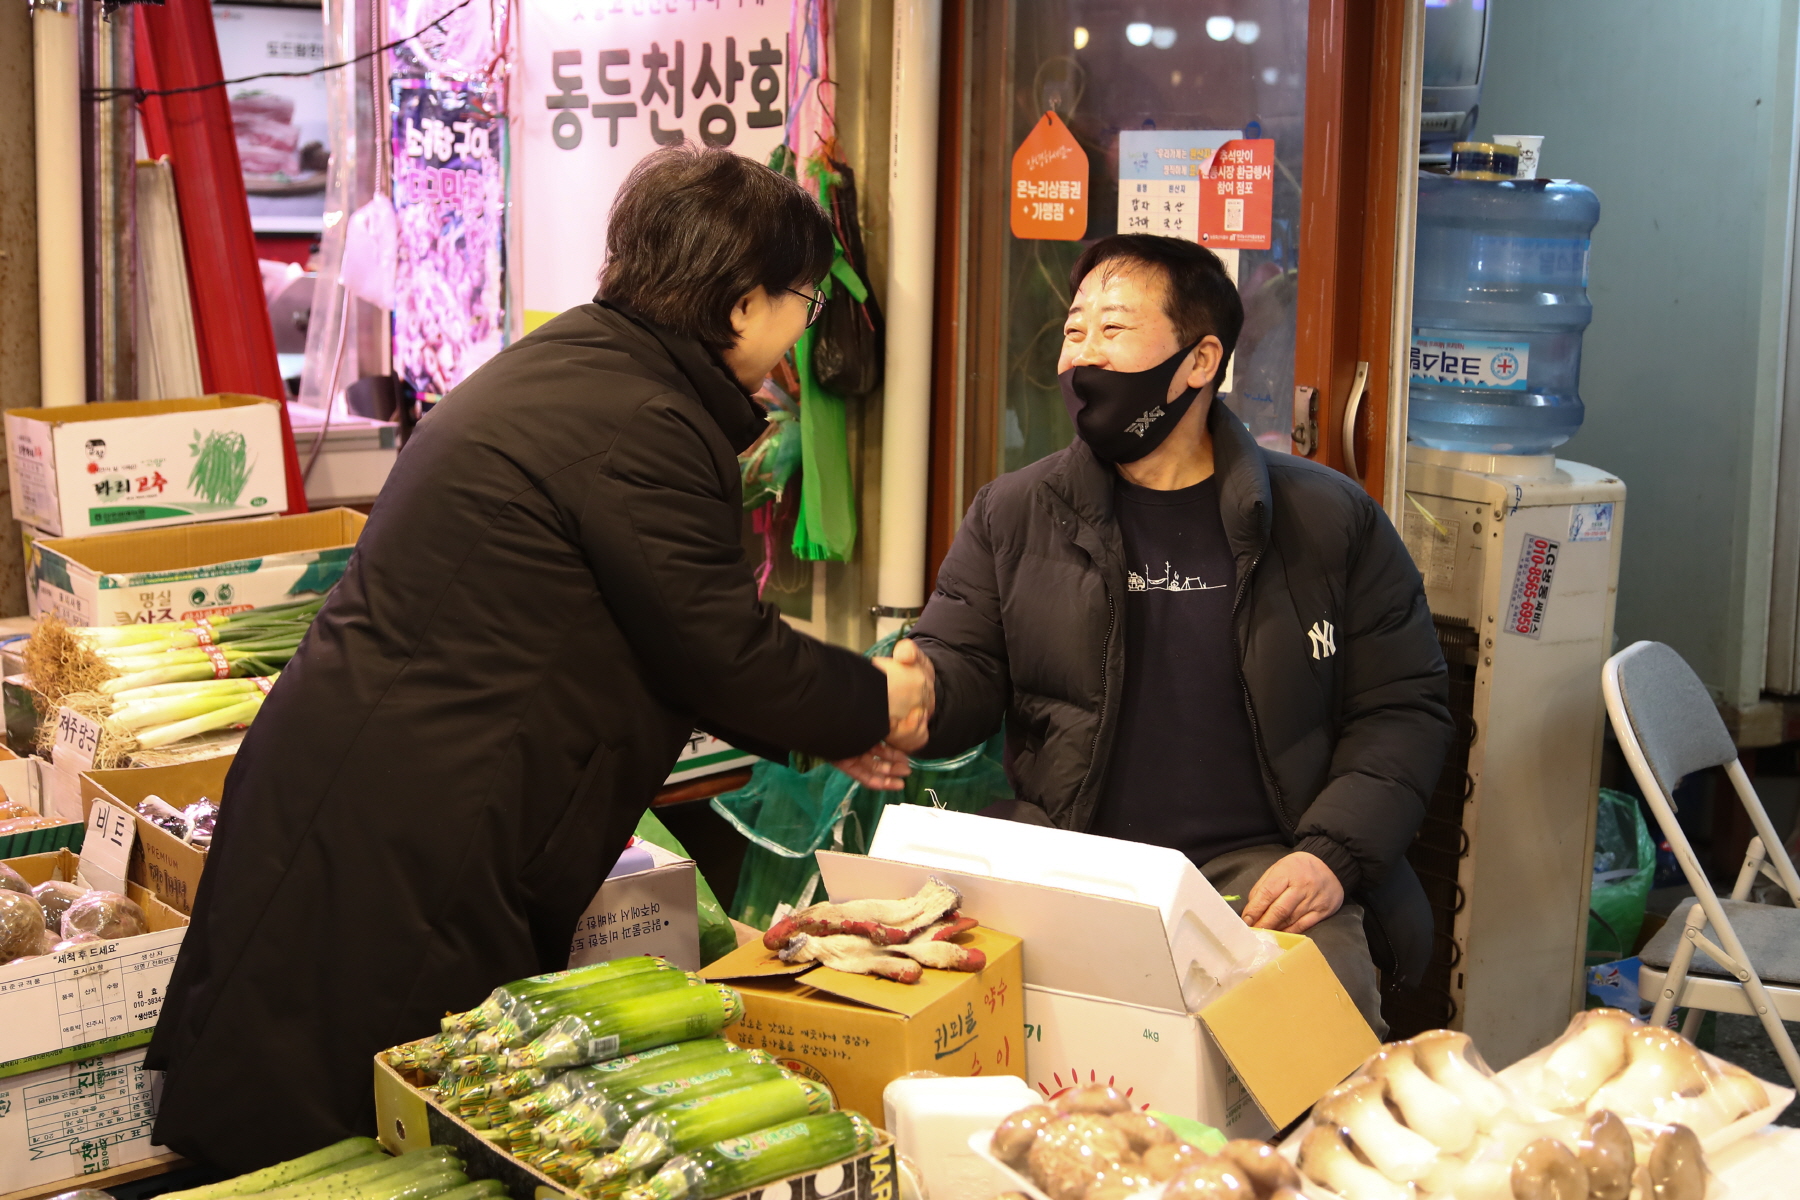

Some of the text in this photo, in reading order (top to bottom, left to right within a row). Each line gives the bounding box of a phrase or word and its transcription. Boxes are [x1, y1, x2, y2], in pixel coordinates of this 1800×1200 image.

[546, 33, 789, 151] 동두천상회
[1220, 149, 1254, 164] 추석맞이
[1236, 165, 1271, 180] 환급행사
[1017, 180, 1081, 199] 온누리상품권
[1217, 181, 1254, 195] 참여 점포
[1032, 202, 1064, 221] 가맹점
[135, 470, 168, 493] 고추
[1545, 543, 1558, 565] LG
[1516, 539, 1548, 634] 010-8565-6959
[1307, 619, 1337, 660] NY
[96, 805, 126, 847] 비트
[146, 842, 179, 870] PREMIUM
[587, 912, 617, 930] 재배한
[621, 902, 660, 922] 여주에서
[588, 930, 618, 948] 비옥한
[78, 949, 88, 961] 후
[984, 977, 1008, 1014] 약수
[1142, 1028, 1160, 1043] 4kg
